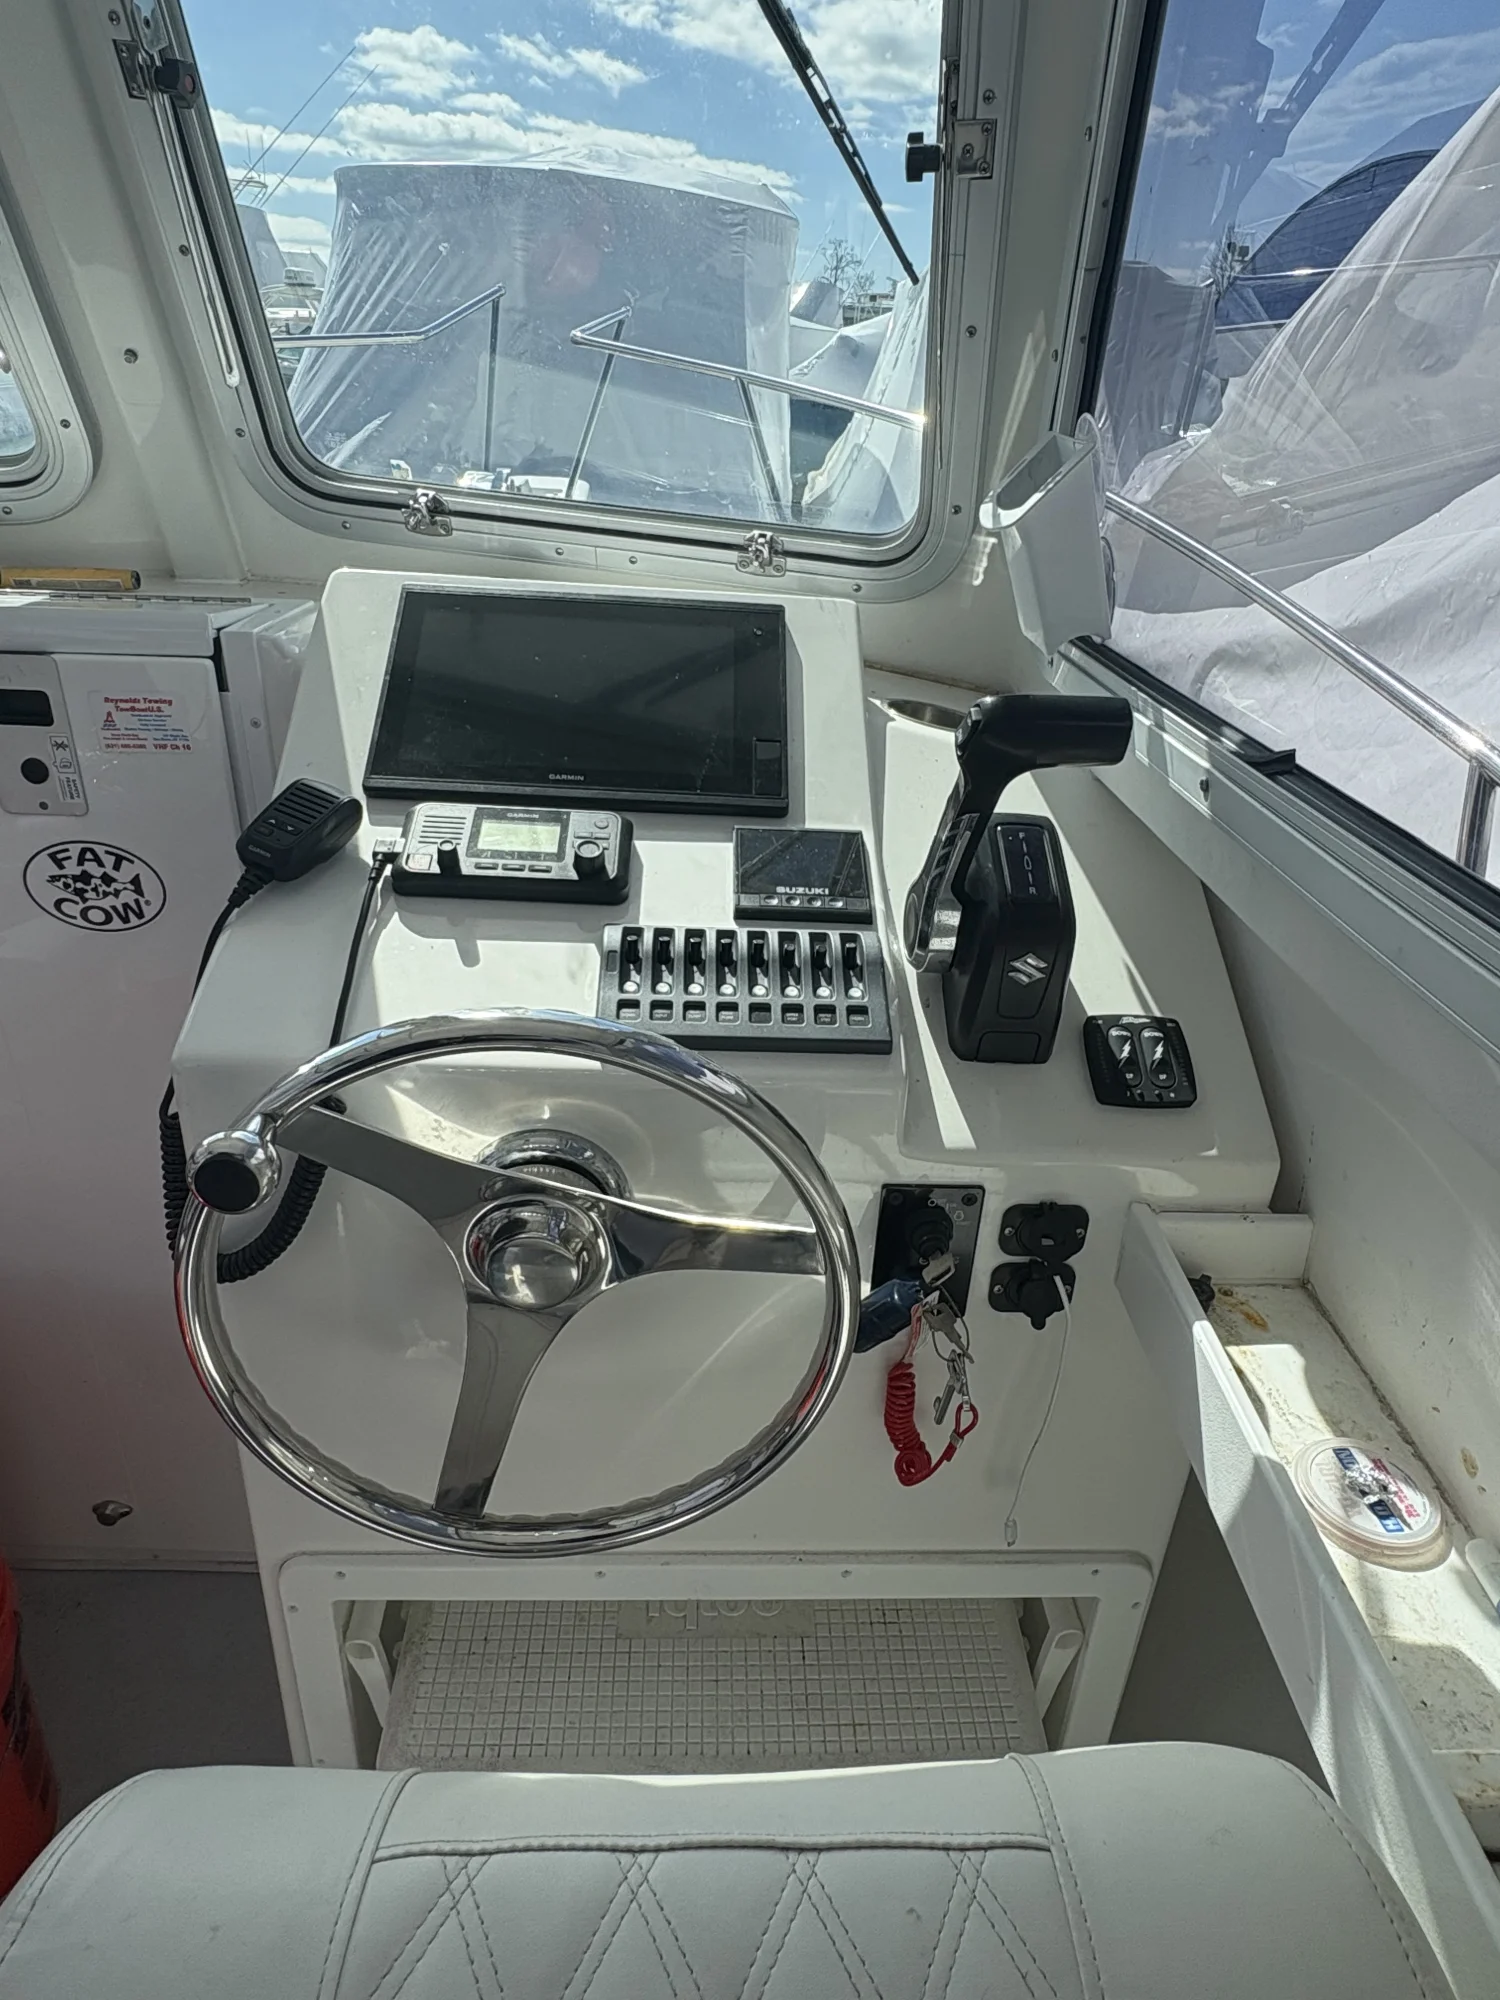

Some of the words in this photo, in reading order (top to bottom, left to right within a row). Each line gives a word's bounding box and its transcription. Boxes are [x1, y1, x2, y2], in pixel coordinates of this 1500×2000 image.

[104, 697, 140, 705] Reynolds
[142, 697, 173, 706] Towing
[548, 773, 585, 782] GARMIN
[47, 847, 135, 873] FAT
[775, 886, 830, 896] SUZUKI
[53, 897, 145, 926] COW
